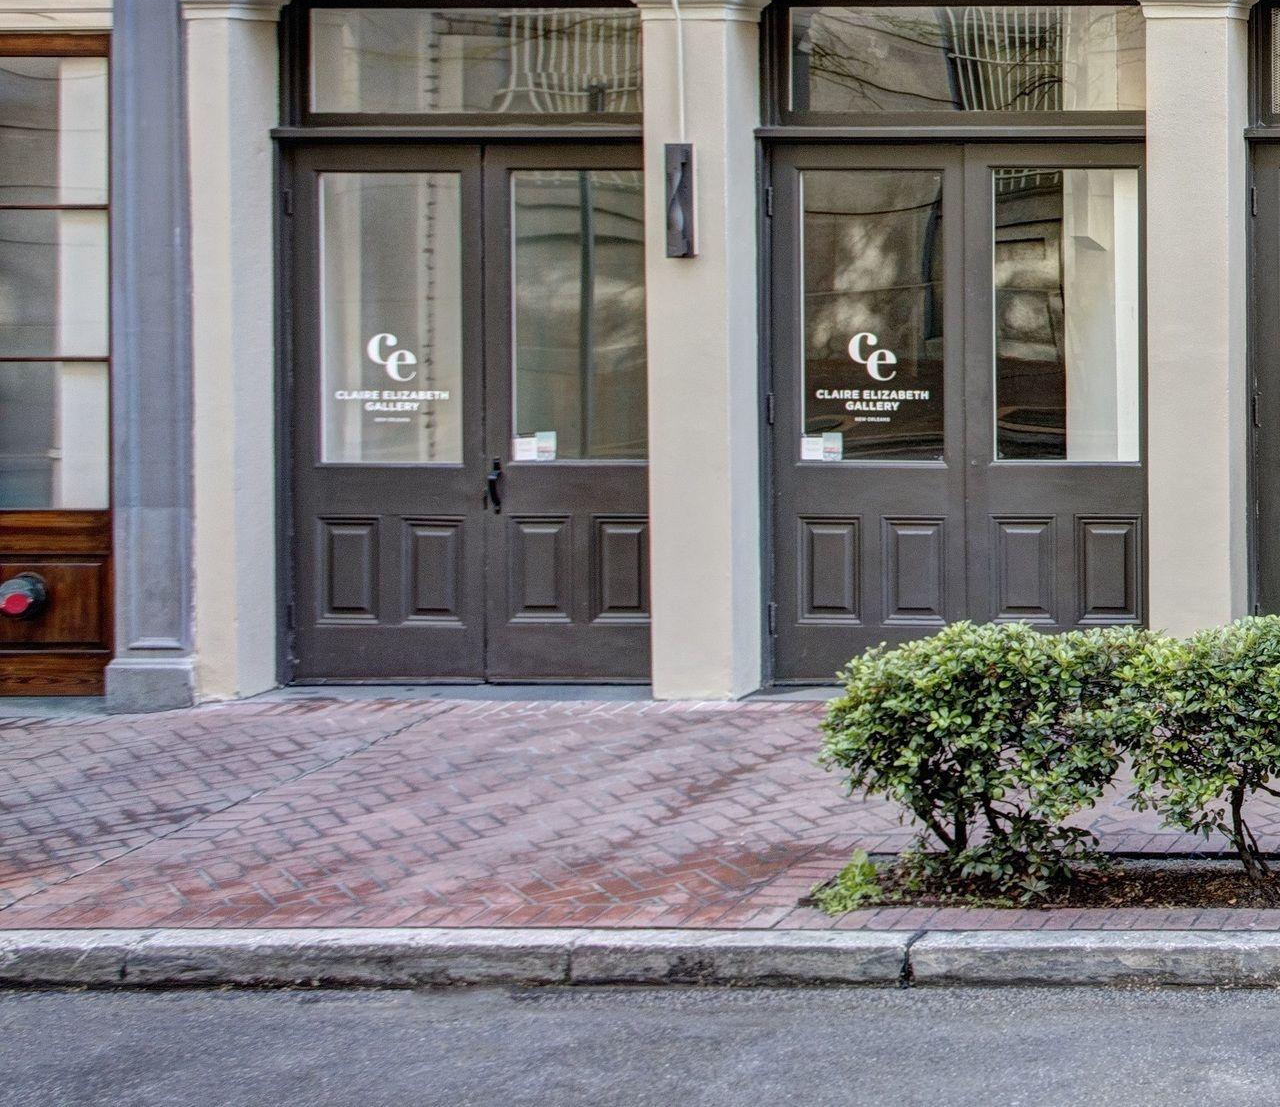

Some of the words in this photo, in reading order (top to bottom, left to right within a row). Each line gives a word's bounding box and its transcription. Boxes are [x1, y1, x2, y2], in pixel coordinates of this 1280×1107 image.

[335, 391, 380, 400] CLAIRE
[382, 391, 450, 400] ELIZABETH
[816, 389, 860, 399] CLAIRE
[862, 390, 930, 400] ELIZABETH
[364, 402, 420, 411] GALLERY
[845, 401, 900, 411] GALLERY
